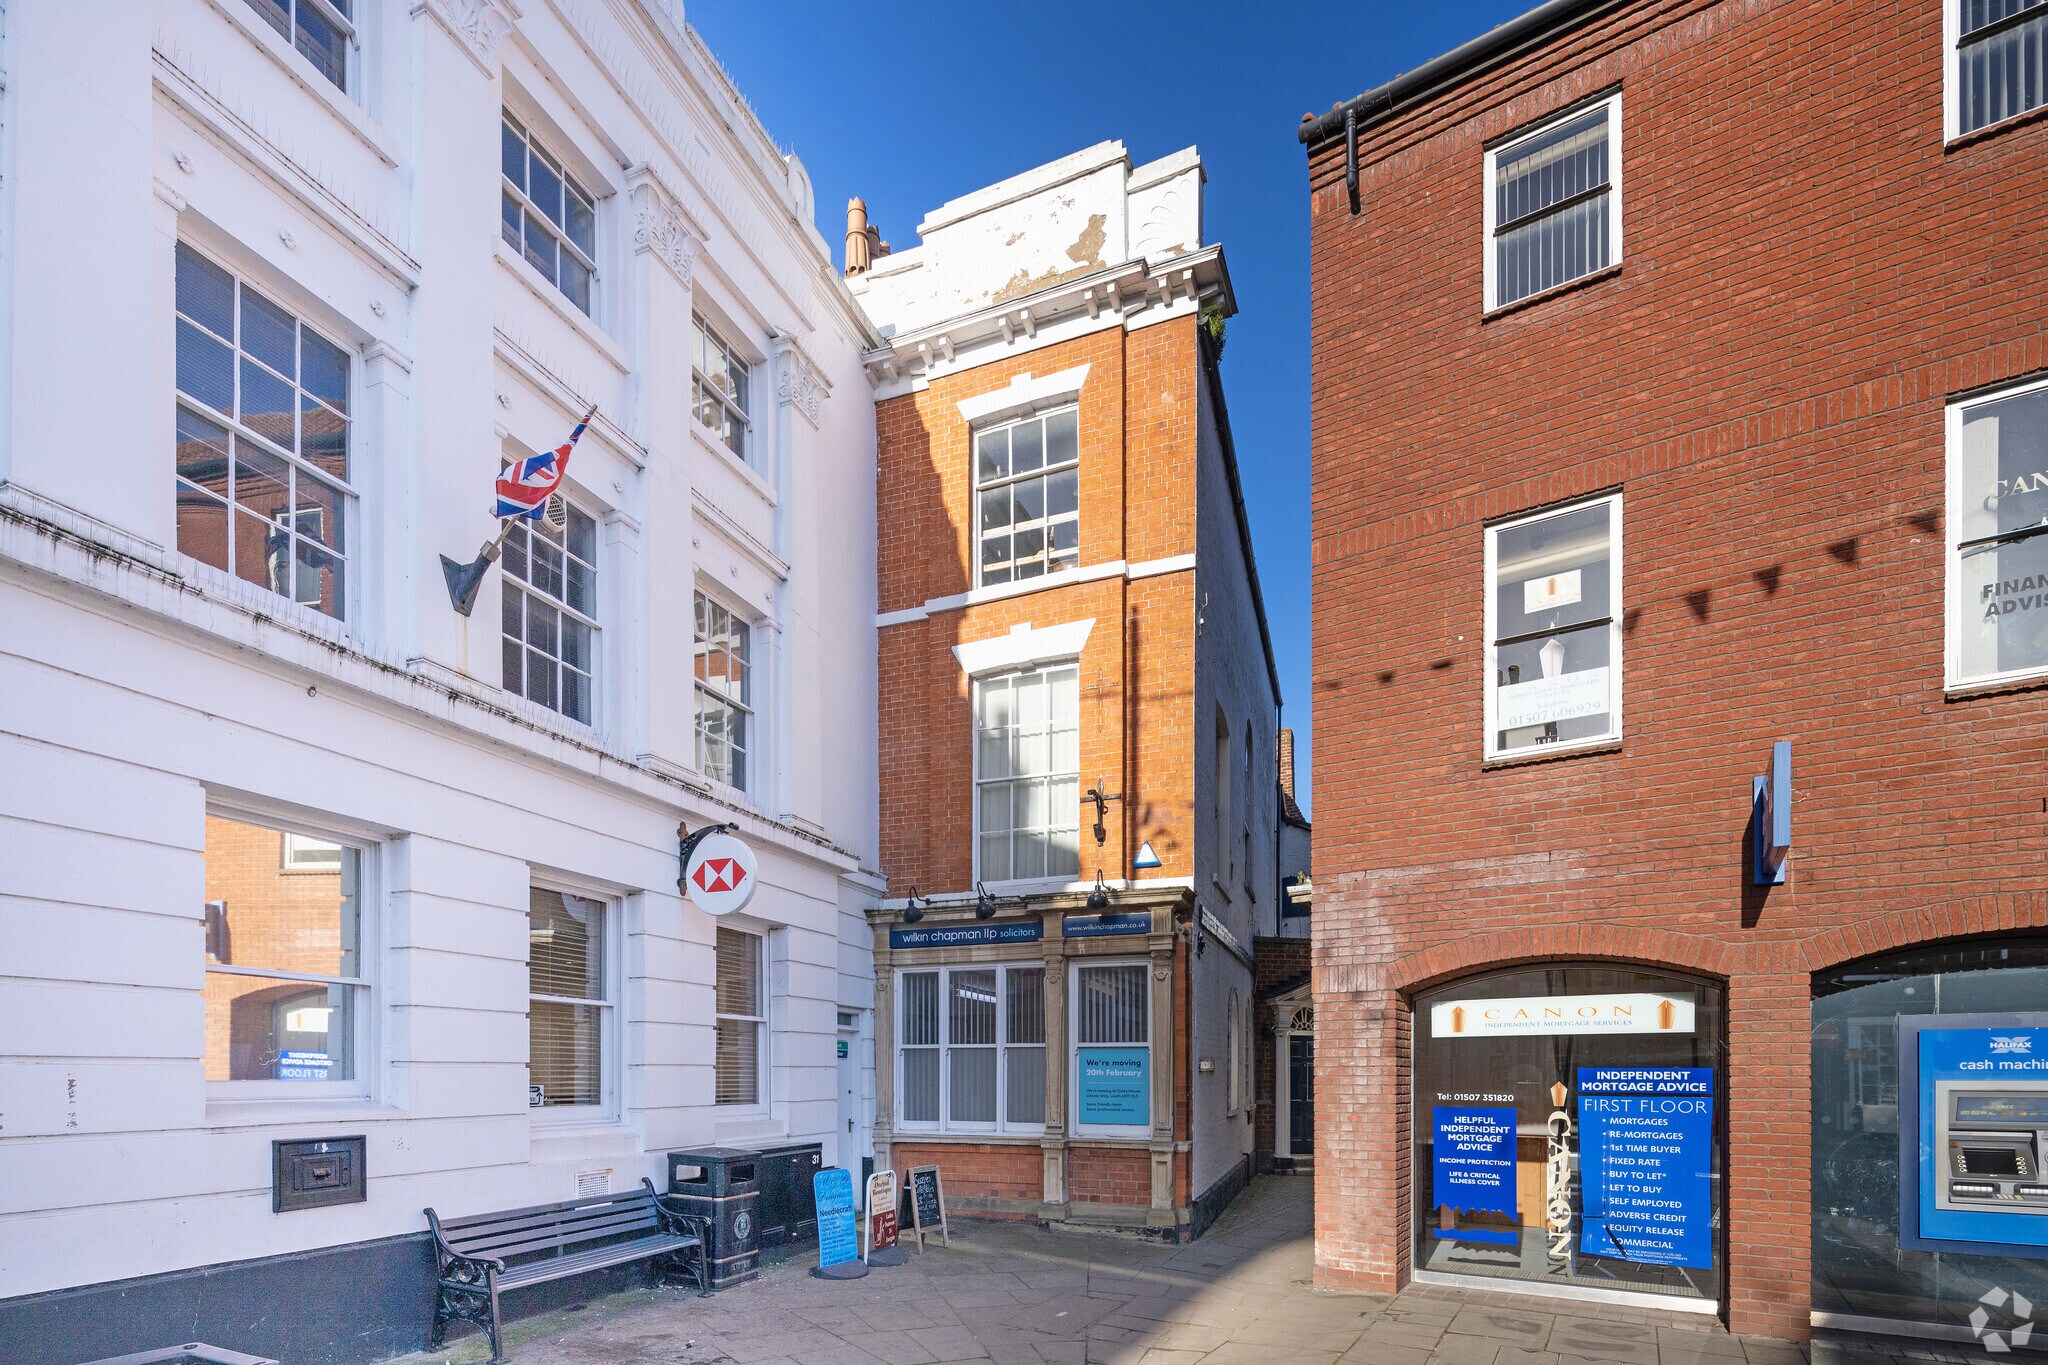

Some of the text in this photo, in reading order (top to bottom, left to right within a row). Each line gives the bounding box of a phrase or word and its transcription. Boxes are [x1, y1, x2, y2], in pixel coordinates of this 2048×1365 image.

[1509, 701, 1600, 727] 01507 606929
[1068, 923, 1145, 932] www.wilkinchapman.co.uk
[902, 928, 1035, 943] wilkin chapman llp solicitors
[1484, 1005, 1633, 1020] CANON
[1112, 1059, 1141, 1067] moving
[1960, 1059, 2048, 1070] cash machi
[1106, 1069, 1141, 1078] February
[1596, 1072, 1690, 1080] INDEPENDENT
[1582, 1082, 1707, 1092] MORTGAGE ADVICE
[1584, 1099, 1707, 1114] FIRST FLOOR
[1454, 1116, 1496, 1124] HELPFUL
[1610, 1118, 1668, 1126] MORTGAGES
[1440, 1125, 1510, 1134] INDEPENDENT
[1448, 1134, 1502, 1142] MORTGAGE
[1609, 1131, 1683, 1140] RE-MORTGAGES
[1610, 1144, 1623, 1152] 1st
[1651, 1146, 1681, 1154] BUYER
[812, 1155, 820, 1164] 31
[1467, 1158, 1511, 1166] PROTECTION
[1631, 1171, 1644, 1179] TO
[1547, 1110, 1571, 1260] CANON
[1632, 1199, 1682, 1208] EMPLOYED
[820, 1205, 852, 1217] Needlecraft
[1610, 1211, 1687, 1222] ADVERSE CREDIT
[1610, 1224, 1684, 1236] EQUITY RELEASE
[1610, 1238, 1673, 1249] COMMERCIAL
